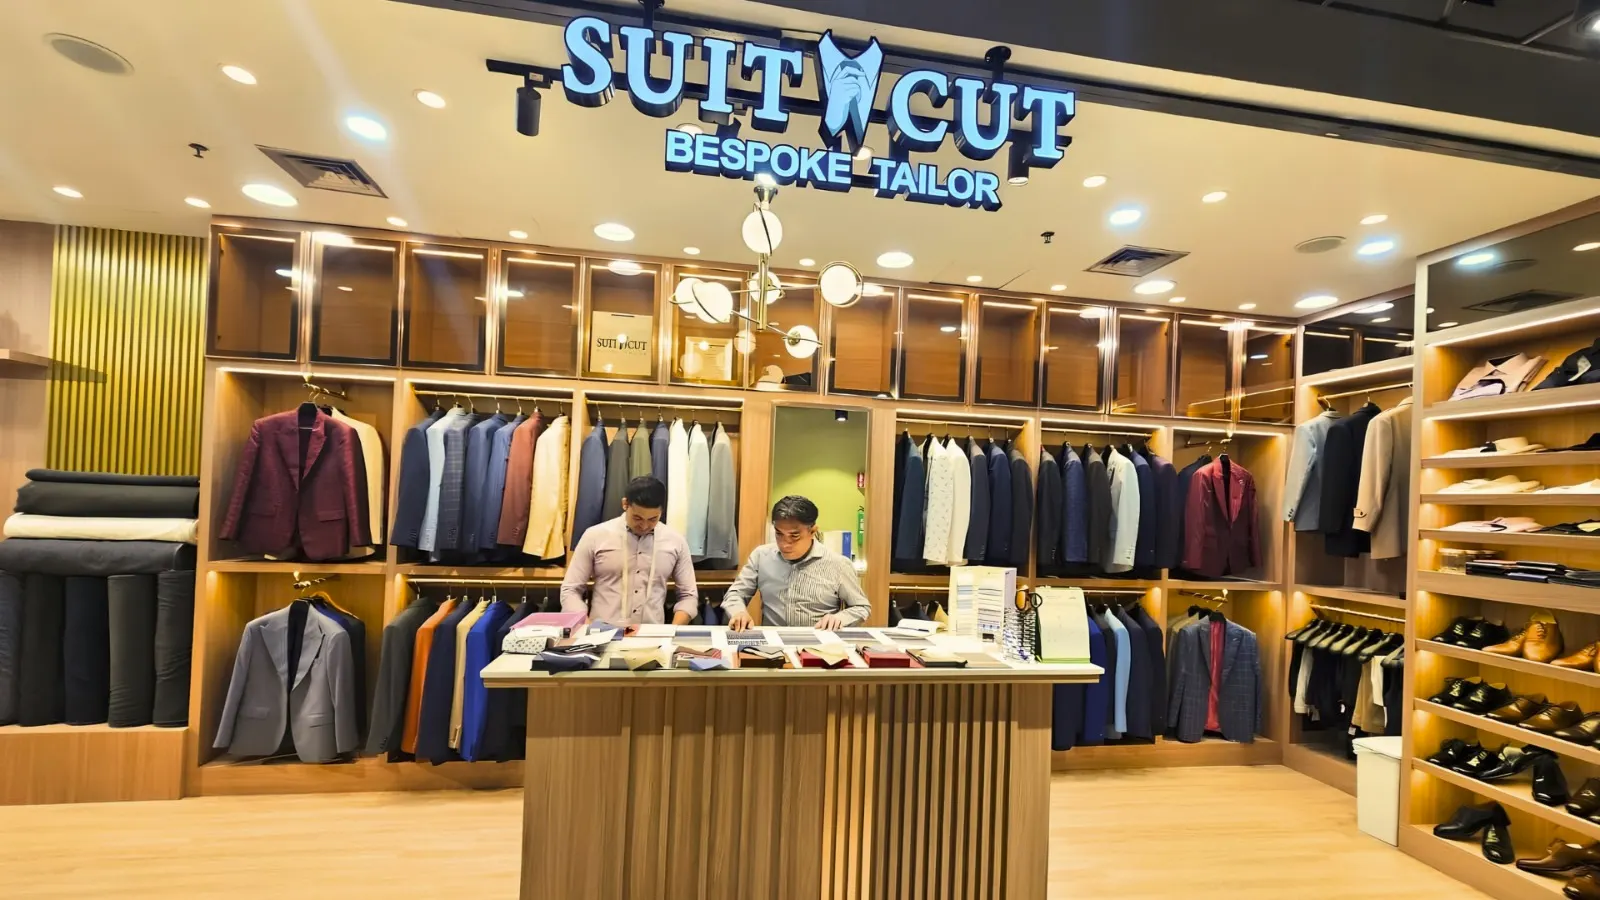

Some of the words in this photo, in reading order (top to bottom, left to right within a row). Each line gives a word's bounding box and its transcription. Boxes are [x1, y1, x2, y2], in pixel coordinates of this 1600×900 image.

[561, 16, 803, 122] SUIT
[890, 69, 1076, 161] CUT
[666, 130, 852, 185] BESPOKE
[873, 158, 999, 204] TAILOR
[627, 340, 648, 351] CUT
